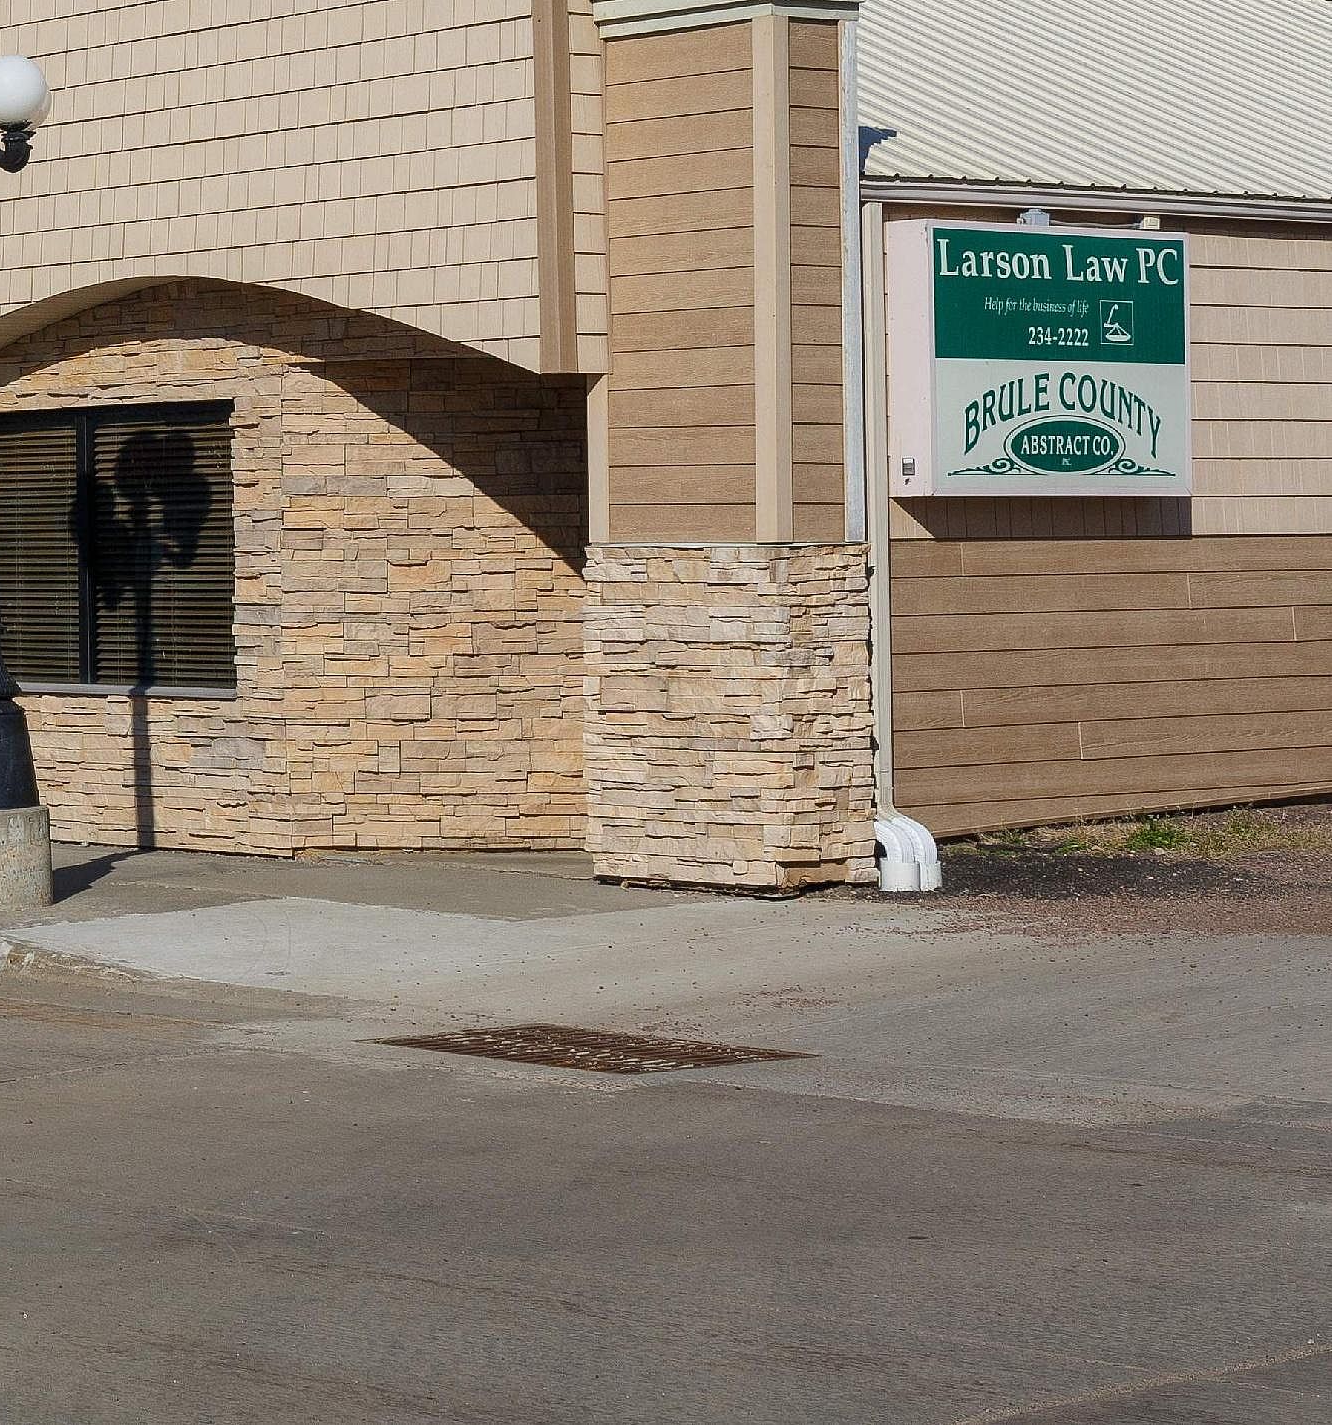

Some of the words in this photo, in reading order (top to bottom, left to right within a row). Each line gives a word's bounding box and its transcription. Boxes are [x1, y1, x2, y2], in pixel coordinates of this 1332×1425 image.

[937, 238, 1052, 280] Larson
[1062, 244, 1128, 282] Law
[1136, 248, 1179, 285] PC
[984, 297, 1003, 315] Help
[1004, 298, 1017, 315] for
[1020, 299, 1032, 311] the
[1033, 300, 1066, 313] business
[1067, 300, 1077, 317] of
[1077, 301, 1090, 318] life
[1028, 326, 1089, 346] 234-2222
[964, 372, 1050, 455] BRULE
[1059, 372, 1161, 459] COUNTY
[1020, 435, 1090, 455] ABSTRACT
[1092, 436, 1114, 456] CO.
